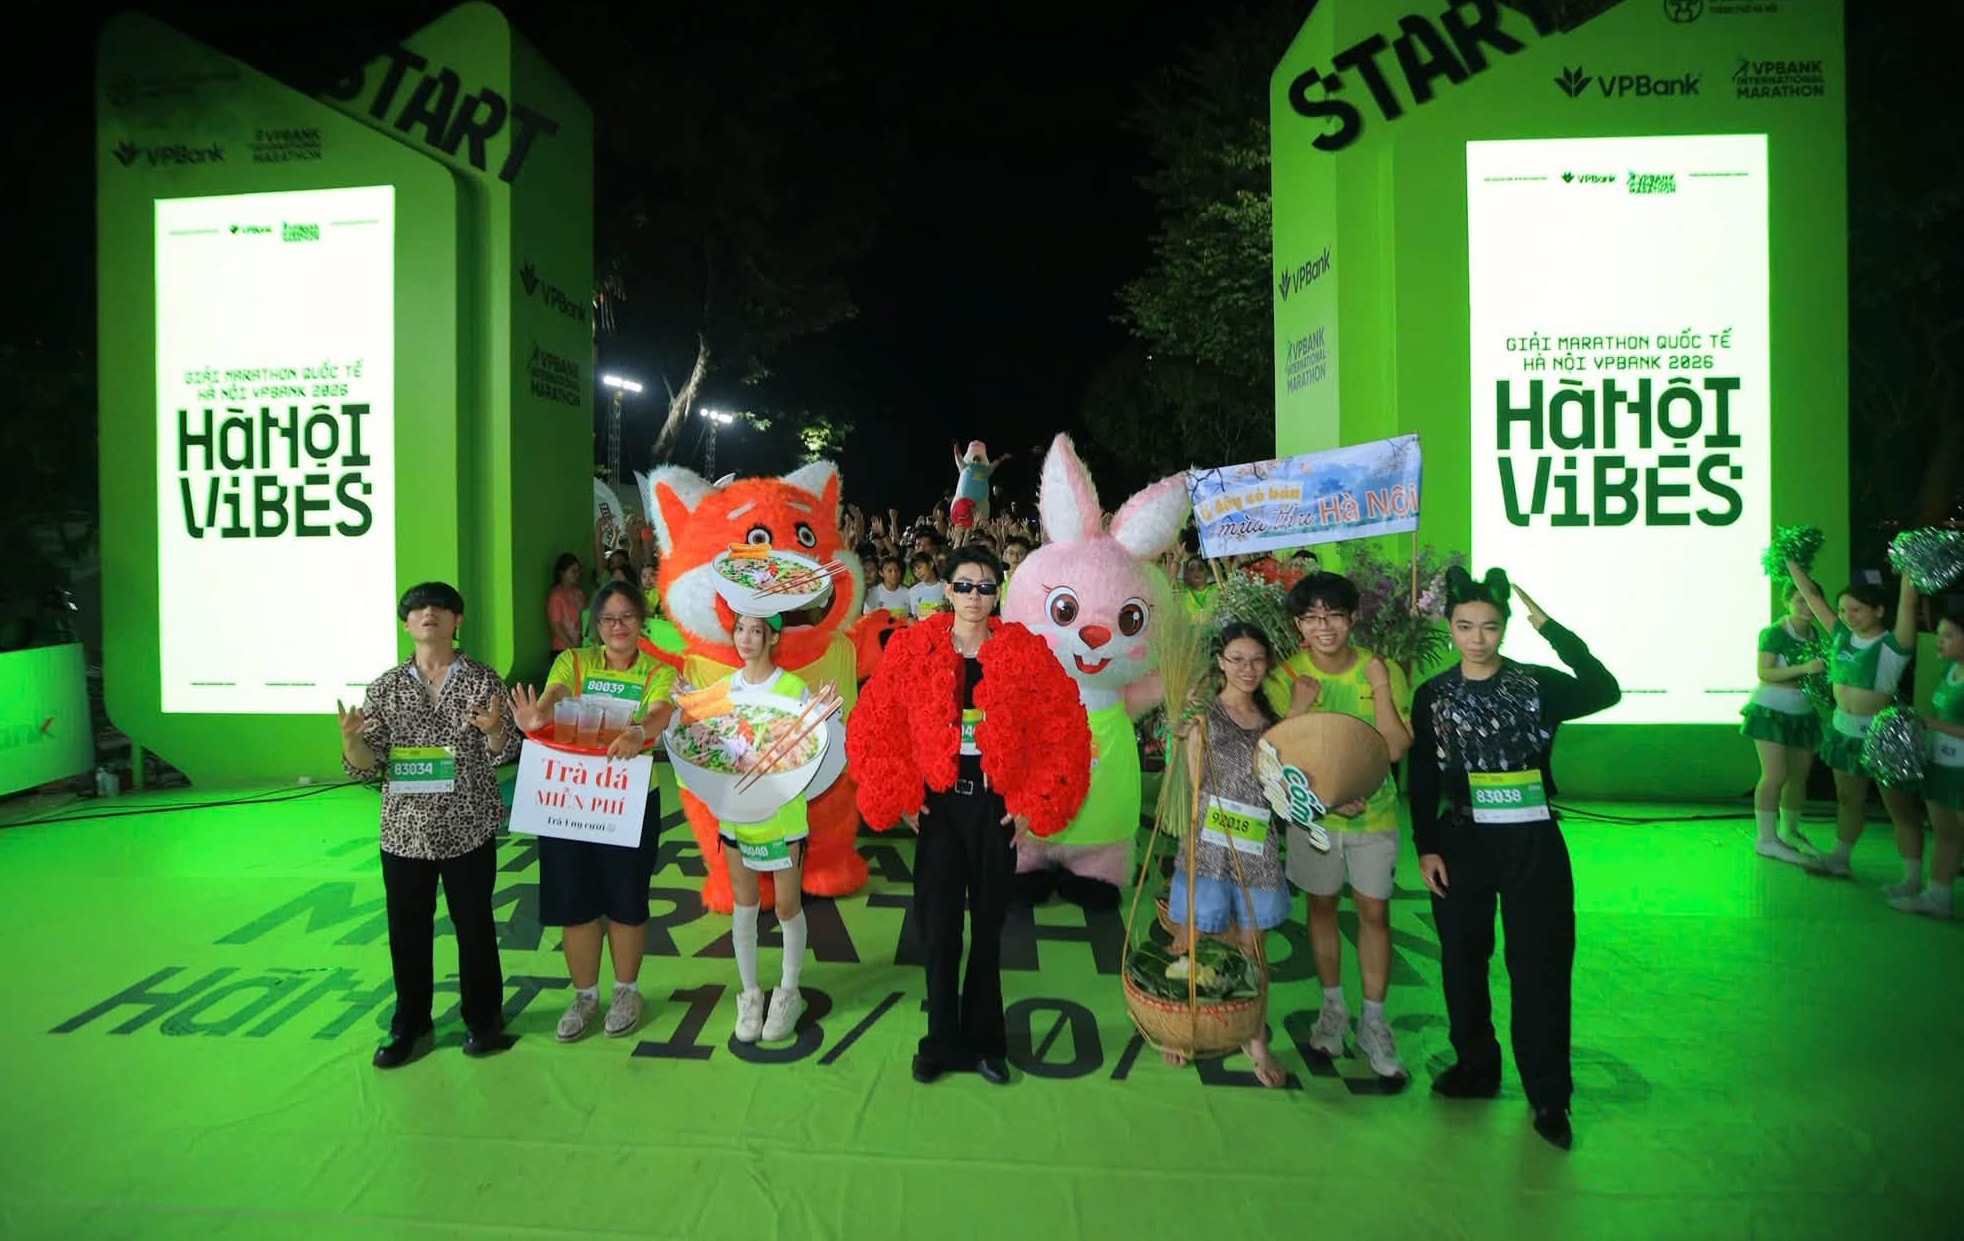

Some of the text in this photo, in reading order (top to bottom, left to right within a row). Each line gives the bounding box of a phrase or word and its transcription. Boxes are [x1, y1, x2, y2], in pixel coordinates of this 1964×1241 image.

[1752, 60, 1824, 74] VPBANK
[1598, 71, 1700, 98] VPBank
[1736, 85, 1825, 99] MARATHON
[147, 142, 226, 167] VPBank
[1293, 246, 1331, 294] VPBank
[1292, 325, 1325, 360] VPBANK
[1558, 335, 1650, 350] MARATHON
[1656, 327, 1701, 349] QUỐC
[1710, 327, 1734, 349] TẾ
[1523, 352, 1714, 374] HÀ NỘI VPBANK 2026
[224, 367, 297, 384] MARATHON
[1286, 362, 1327, 395] MARATHON
[311, 383, 350, 398] 2026
[1318, 491, 1360, 526] Hà
[1365, 483, 1419, 520] Nội
[588, 680, 625, 694] 80039
[394, 761, 433, 776] 83034
[541, 757, 587, 786] Trà
[1211, 811, 1250, 833] 92018
